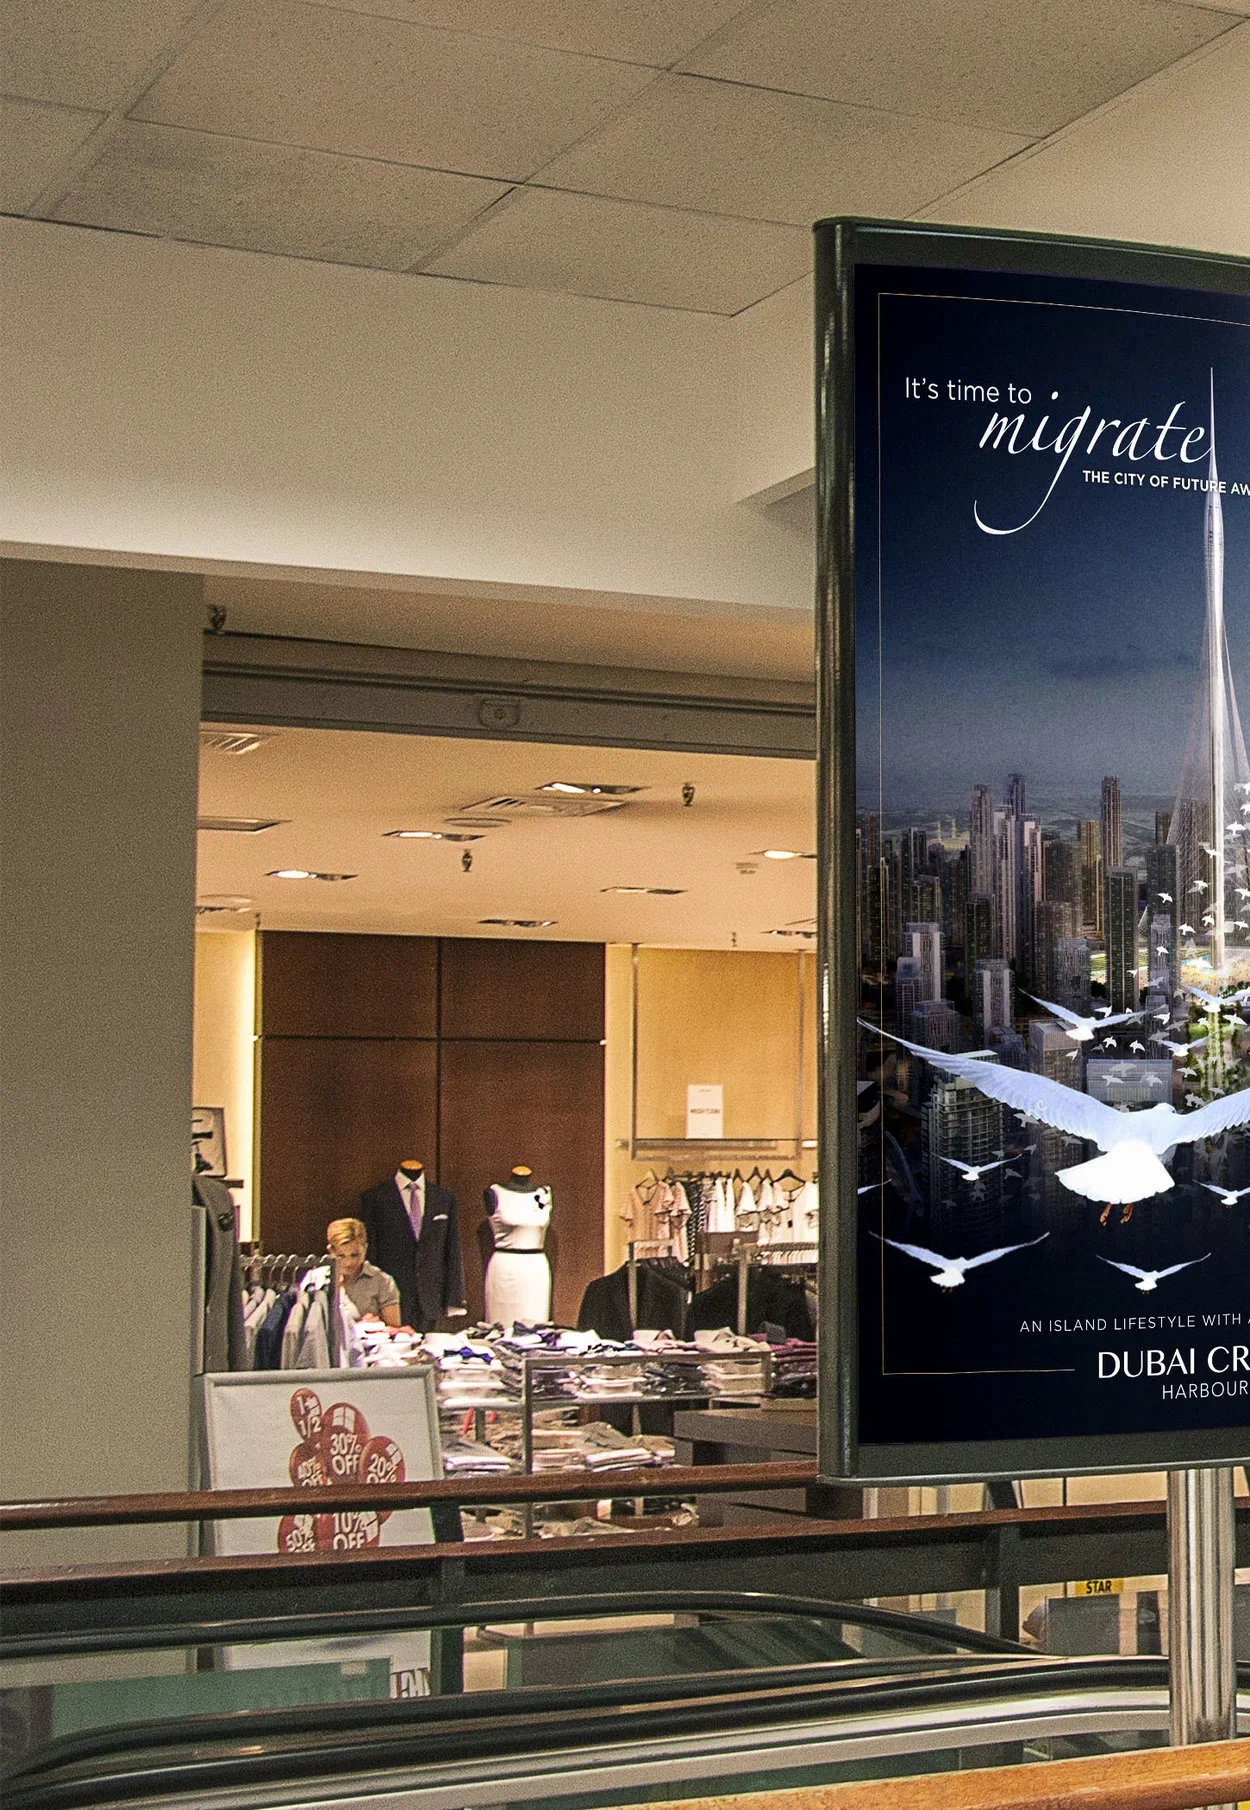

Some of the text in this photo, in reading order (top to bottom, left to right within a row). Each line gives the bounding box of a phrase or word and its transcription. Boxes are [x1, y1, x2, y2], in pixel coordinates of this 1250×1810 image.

[946, 379, 1000, 403] time
[1007, 383, 1032, 405] to
[973, 391, 1213, 535] migrate
[1082, 469, 1110, 484] THE
[1114, 472, 1146, 487] CITY
[1149, 475, 1169, 488] OF
[1172, 477, 1227, 493] FUTURE
[1019, 1320, 1042, 1333] AN
[1050, 1319, 1107, 1332] ISLAND
[1114, 1315, 1196, 1331] LIFESTYLE
[1202, 1313, 1241, 1327] WITH
[1098, 1347, 1195, 1379] DUBAI
[1162, 1380, 1249, 1400] HARBOUR
[329, 1432, 362, 1456] 30%
[331, 1455, 360, 1475] OFF
[367, 1453, 398, 1483] 20%
[1086, 1580, 1112, 1594] STAR
